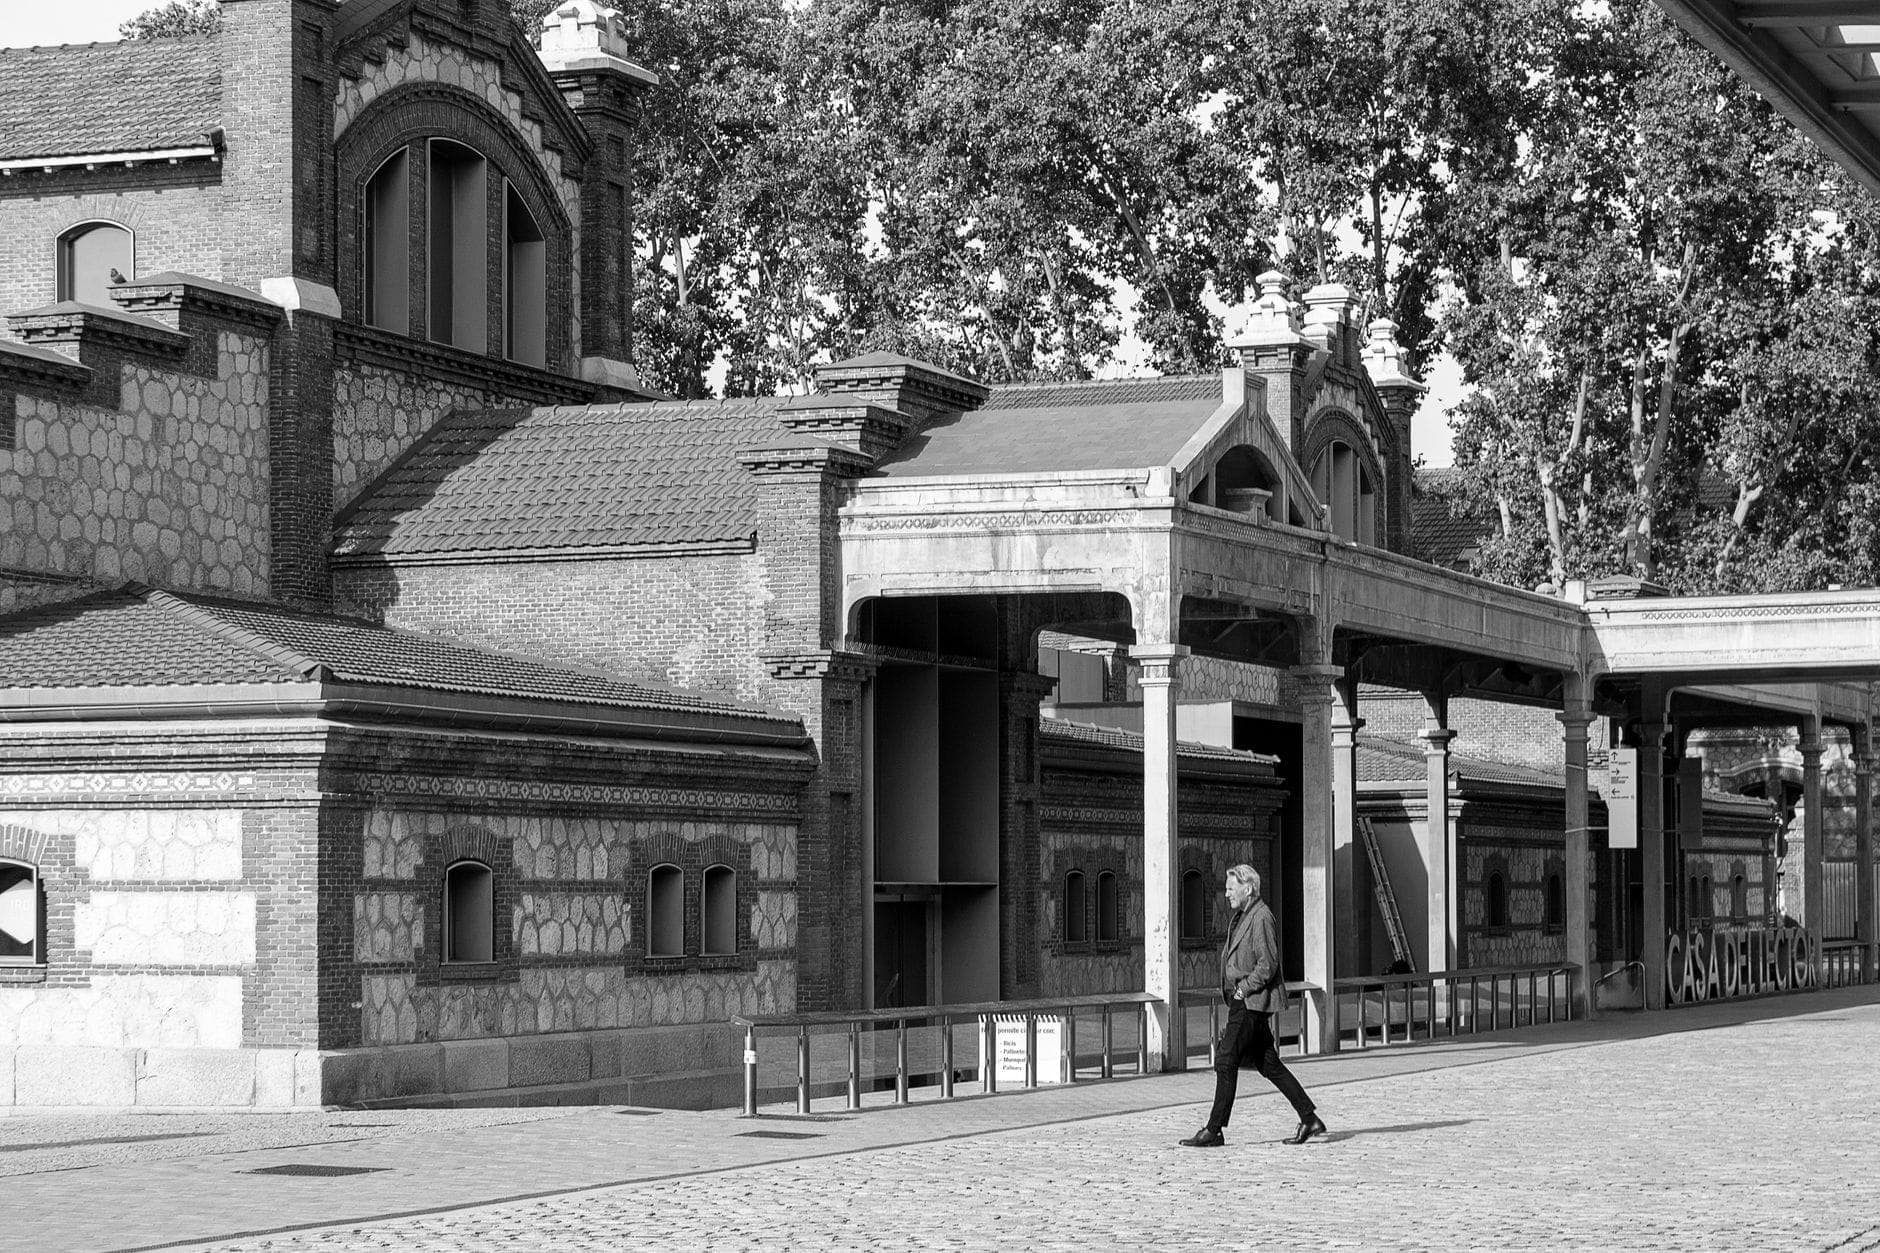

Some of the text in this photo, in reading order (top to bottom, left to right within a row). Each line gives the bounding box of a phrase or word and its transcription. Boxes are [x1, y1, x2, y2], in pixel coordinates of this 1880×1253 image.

[1667, 928, 1817, 1003] CASA DEL LECTOR
